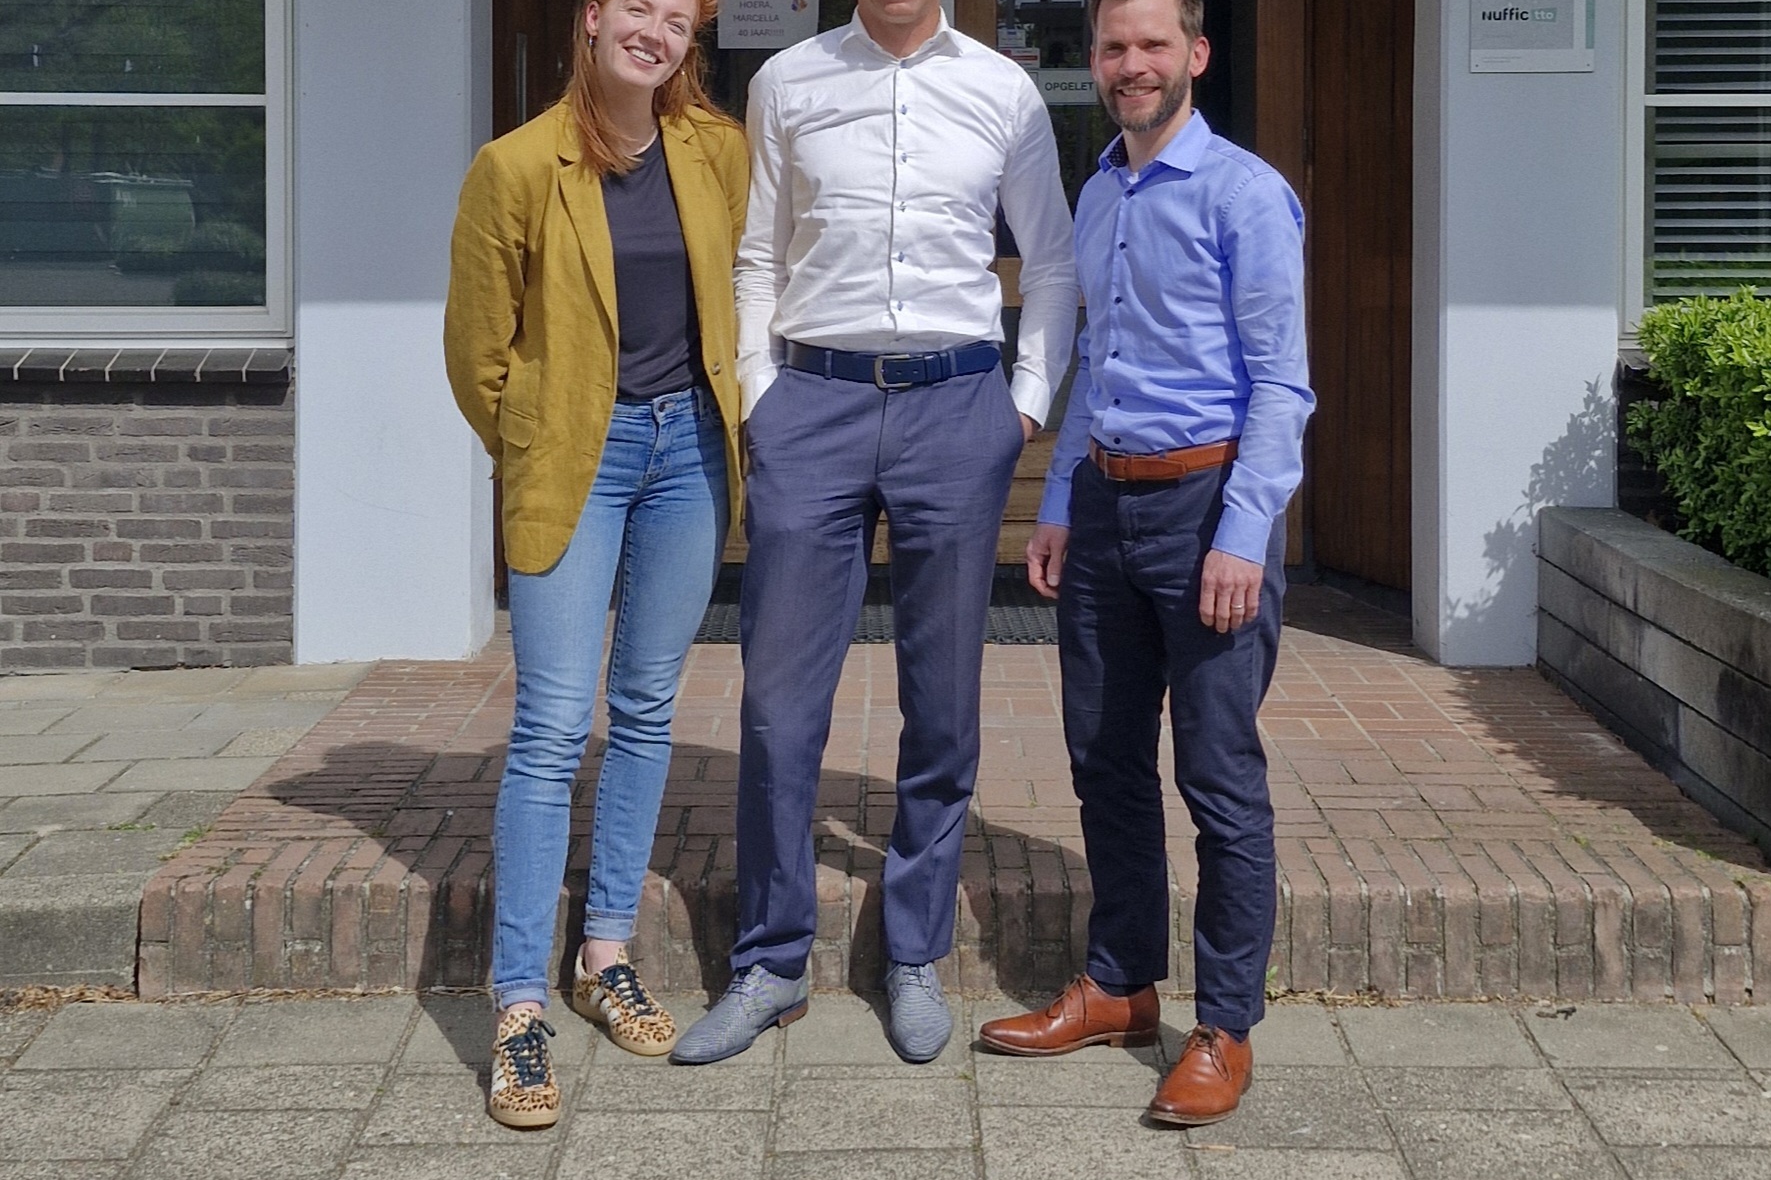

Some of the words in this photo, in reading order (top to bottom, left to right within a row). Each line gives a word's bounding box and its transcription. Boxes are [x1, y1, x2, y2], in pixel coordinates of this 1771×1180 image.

[739, 1, 773, 9] HOERA,
[732, 14, 780, 22] MARCELLA
[1534, 9, 1555, 21] tto
[738, 29, 749, 37] 40
[1044, 81, 1094, 91] OPGELET
